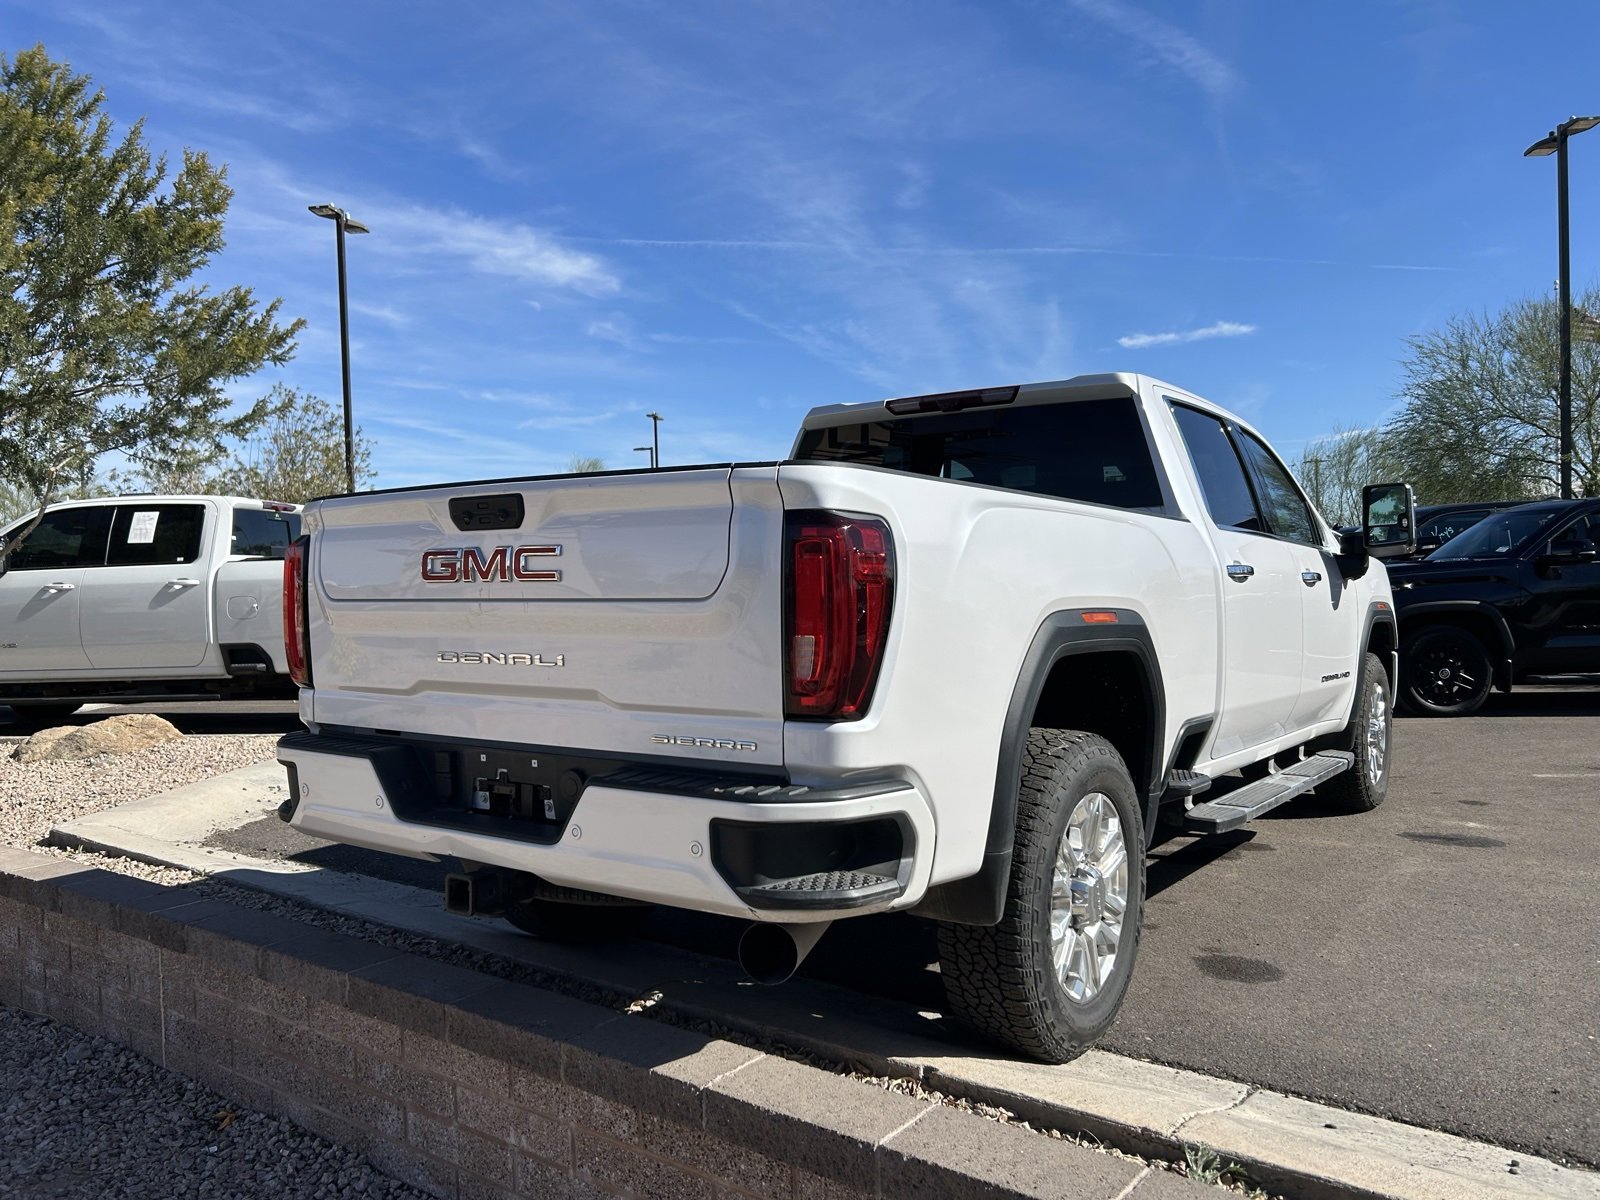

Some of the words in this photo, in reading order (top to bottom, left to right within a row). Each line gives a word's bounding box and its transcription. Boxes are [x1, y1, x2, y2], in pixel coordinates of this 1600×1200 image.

[421, 544, 562, 583] GMC
[437, 651, 565, 667] DENALI
[651, 733, 757, 751] SIERRA
